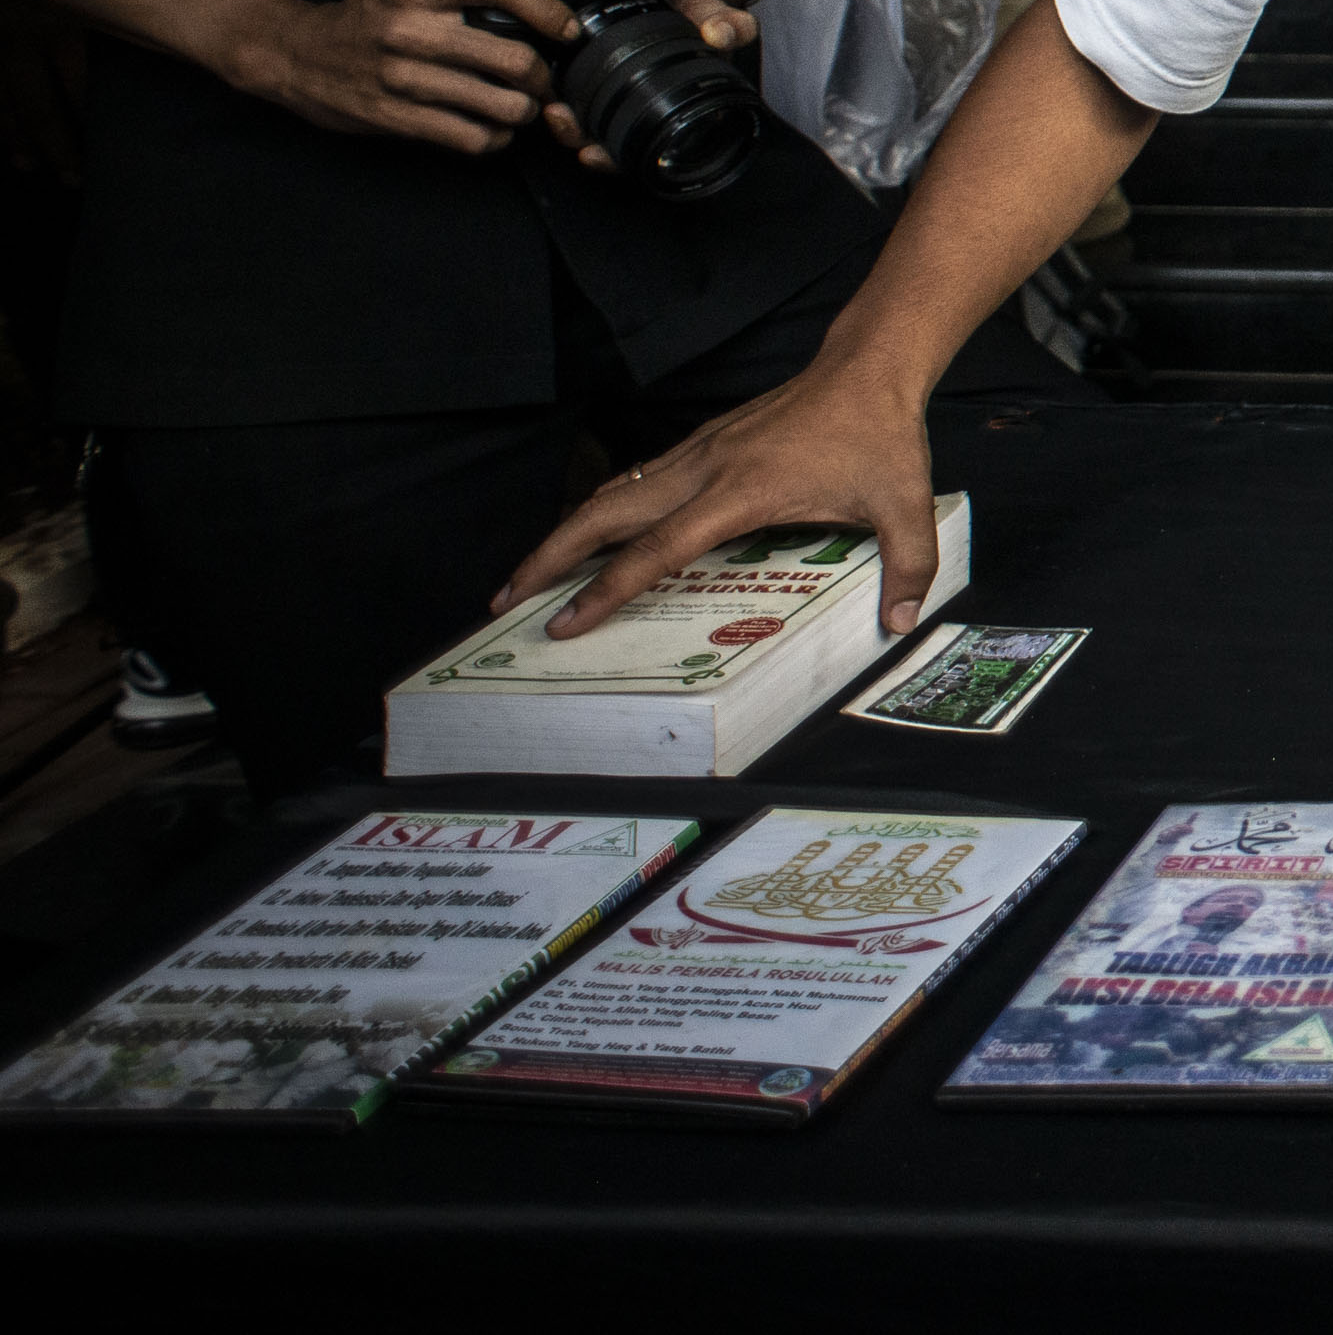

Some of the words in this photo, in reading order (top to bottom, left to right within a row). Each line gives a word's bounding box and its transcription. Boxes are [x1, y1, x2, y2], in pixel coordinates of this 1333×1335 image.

[713, 569, 834, 582] MA'RUF
[676, 583, 819, 596] MUNKAR
[405, 816, 450, 827] Front
[450, 817, 511, 829] Pembela
[348, 814, 584, 855] ISLAM
[1160, 855, 1322, 872] SPIRIT
[592, 961, 664, 976] MAJLIS
[669, 965, 758, 981] PEMBELA
[765, 969, 899, 986] ROSULULLAH
[1104, 951, 1238, 976] TABLIGH
[567, 991, 617, 1003] Makna
[618, 993, 636, 1004] Di
[636, 995, 744, 1011] Selenggarakan
[744, 1000, 786, 1011] Acara
[788, 1001, 823, 1012] Houl
[582, 981, 633, 993] Ummat
[636, 983, 668, 997] Yang
[673, 985, 691, 995] Di
[692, 986, 769, 1001] Banggakan
[771, 989, 801, 1000] Nabi
[801, 990, 890, 1004] Muhammad
[1043, 978, 1140, 1006] AKSI
[1141, 979, 1235, 1007] BELA
[539, 1013, 580, 1024] Cinta
[580, 1015, 635, 1029] Kepada
[636, 1018, 685, 1029] Ulama
[553, 1002, 612, 1014] Karunia
[614, 1005, 652, 1016] Allah
[653, 1007, 687, 1021] Yang
[689, 1009, 734, 1022] Paling
[736, 1011, 780, 1022] Besar
[499, 1022, 546, 1034] Bonus
[547, 1025, 590, 1037] Track
[509, 1036, 562, 1048] Hukum
[564, 1038, 599, 1052] Yang
[601, 1041, 633, 1053] Haq
[635, 1042, 650, 1052] &
[651, 1044, 688, 1057] Yang
[691, 1045, 738, 1057] Bathil
